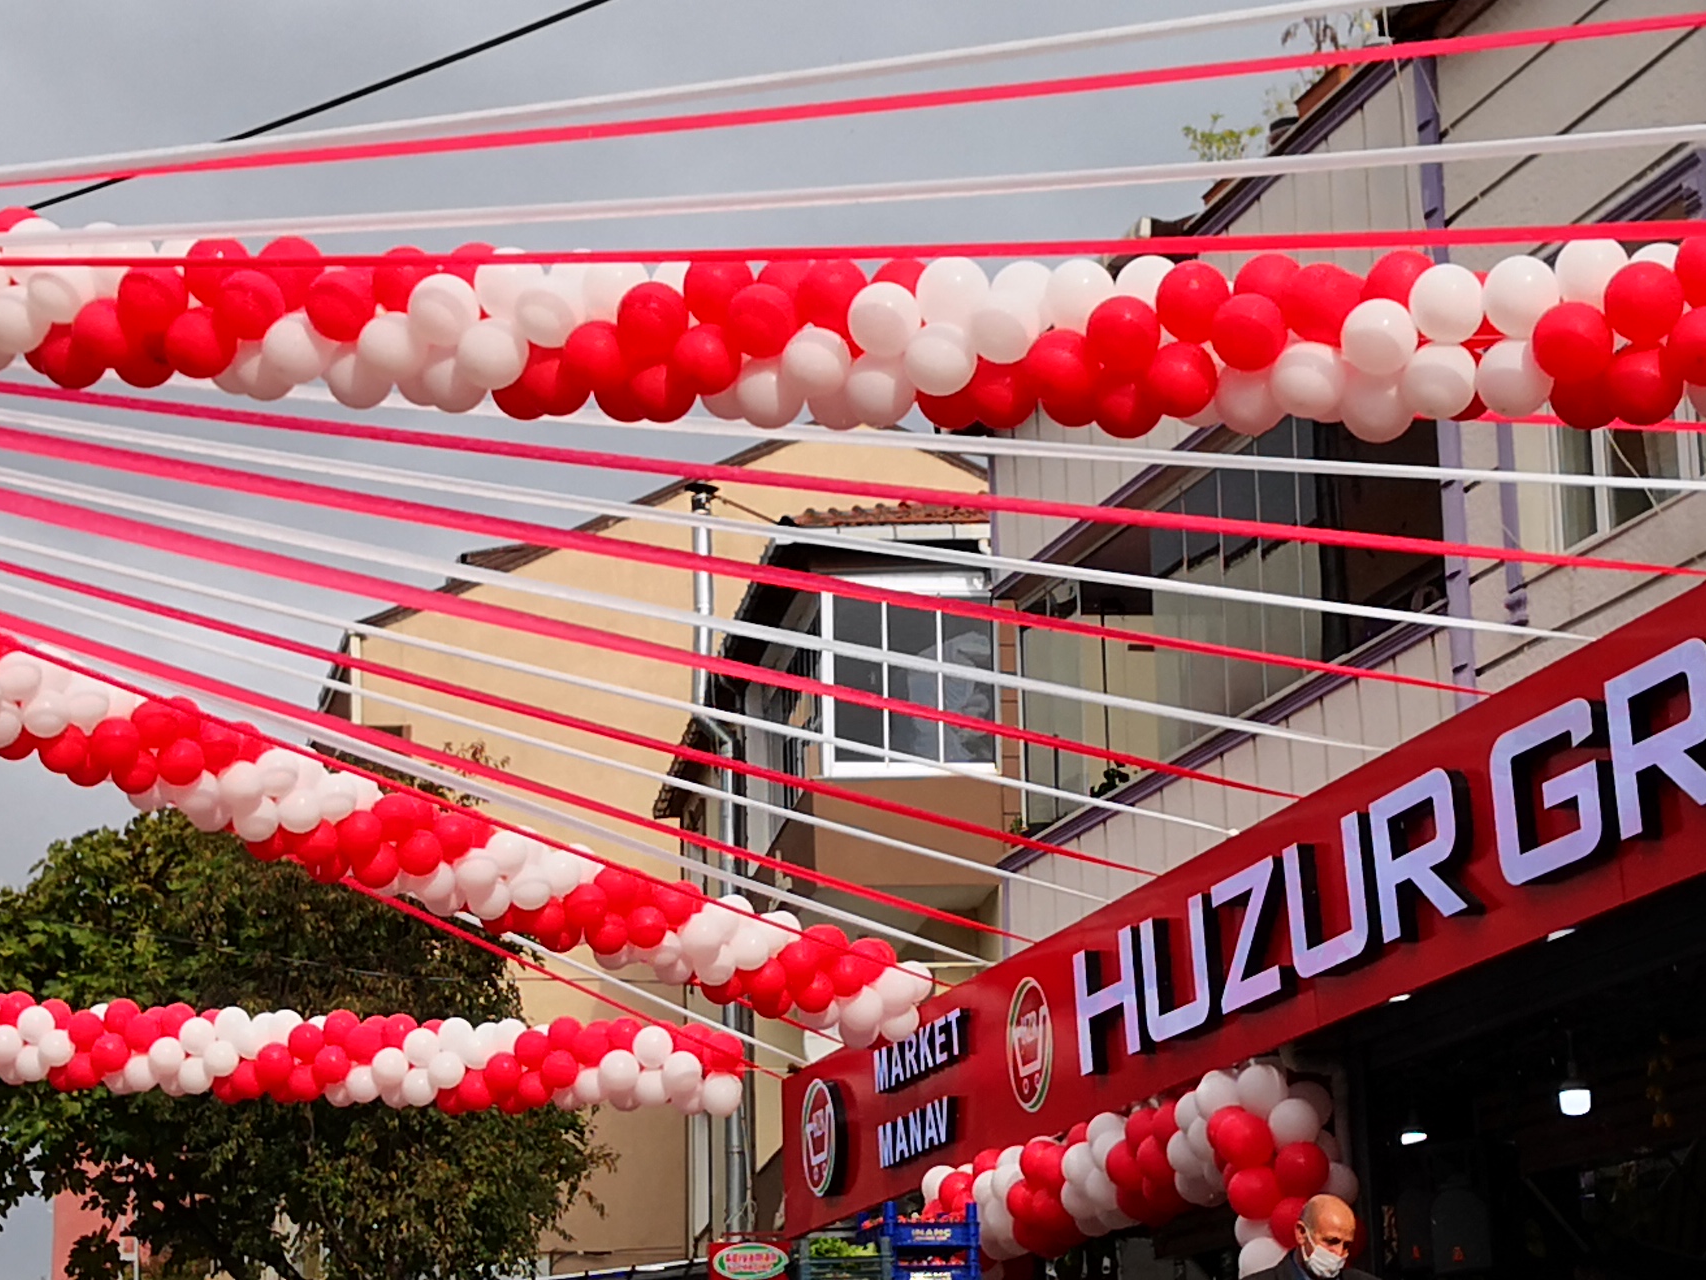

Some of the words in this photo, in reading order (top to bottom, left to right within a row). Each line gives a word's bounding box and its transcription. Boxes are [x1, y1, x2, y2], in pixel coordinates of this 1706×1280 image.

[1072, 767, 1468, 1076] HUZUR
[873, 1007, 961, 1094] MARKET
[877, 1095, 948, 1168] MANAV
